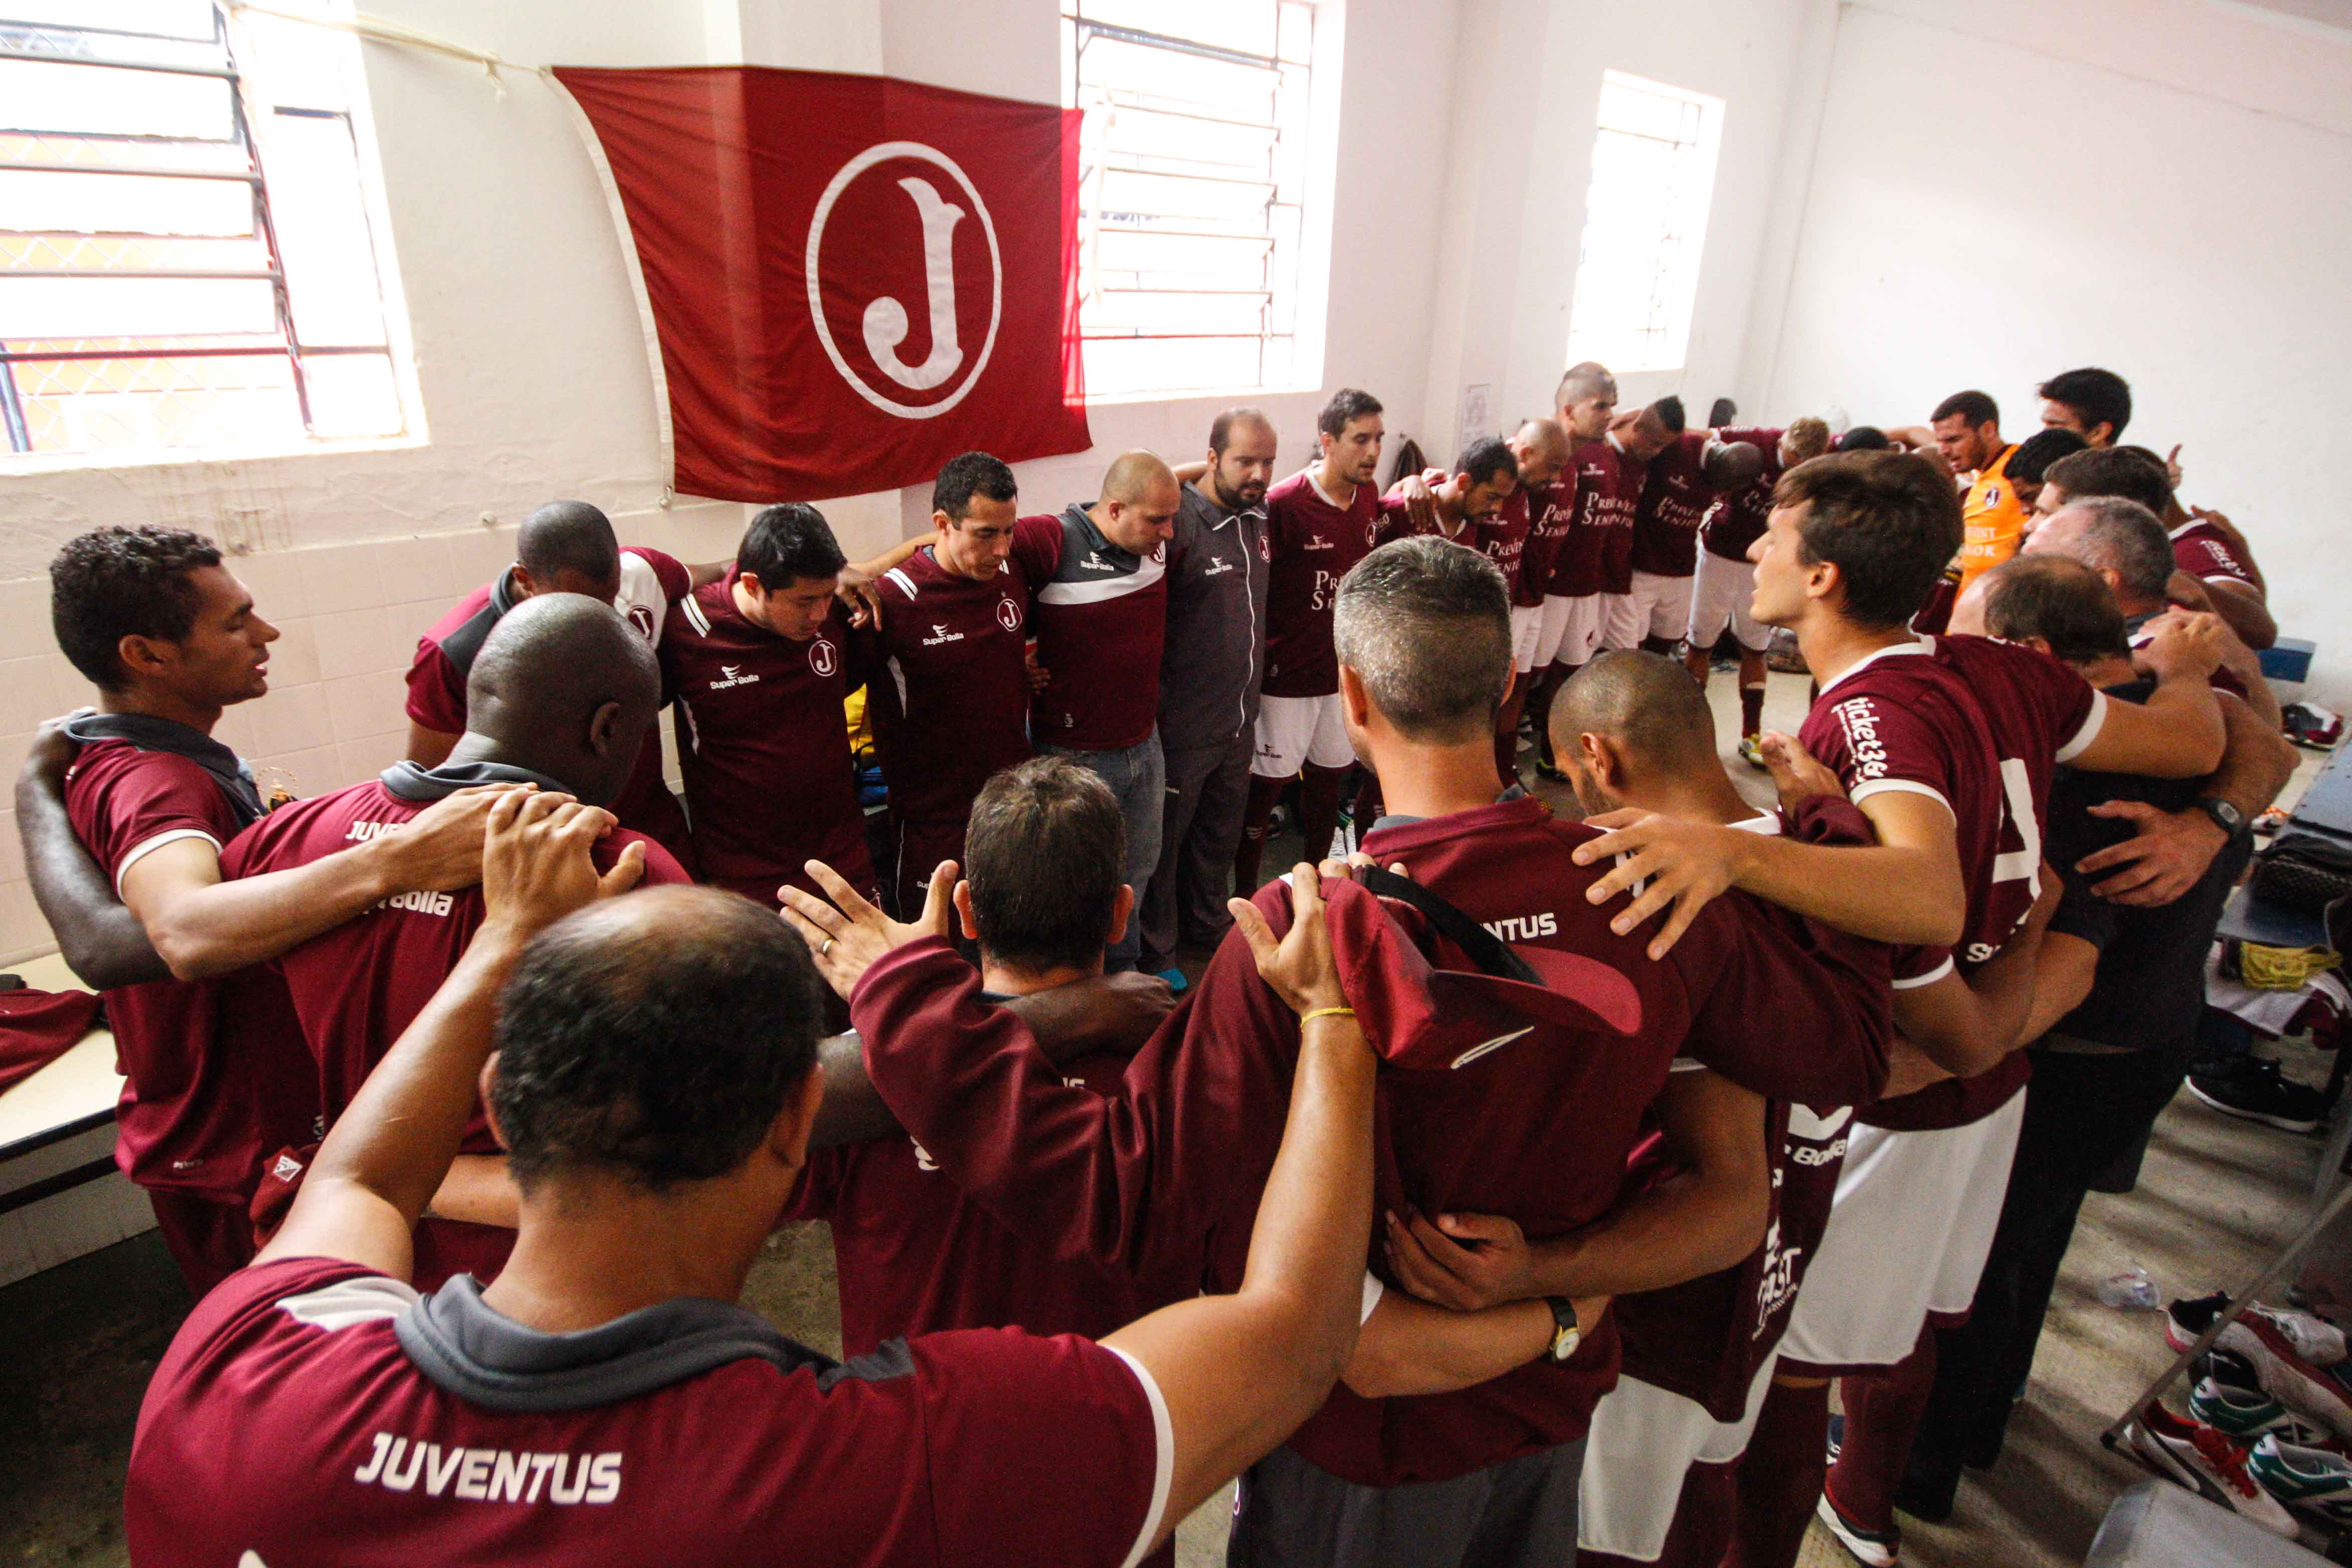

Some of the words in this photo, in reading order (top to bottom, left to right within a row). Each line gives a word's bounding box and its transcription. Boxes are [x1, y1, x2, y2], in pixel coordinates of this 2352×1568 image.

[863, 177, 966, 390] J
[923, 636, 947, 645] Super
[947, 632, 964, 641] Bolla
[710, 679, 737, 690] Super
[737, 675, 760, 685] Bolla
[1844, 697, 1888, 780] ticket36
[1479, 912, 1558, 942] NTUS
[354, 1431, 623, 1504] JUVENTUS
